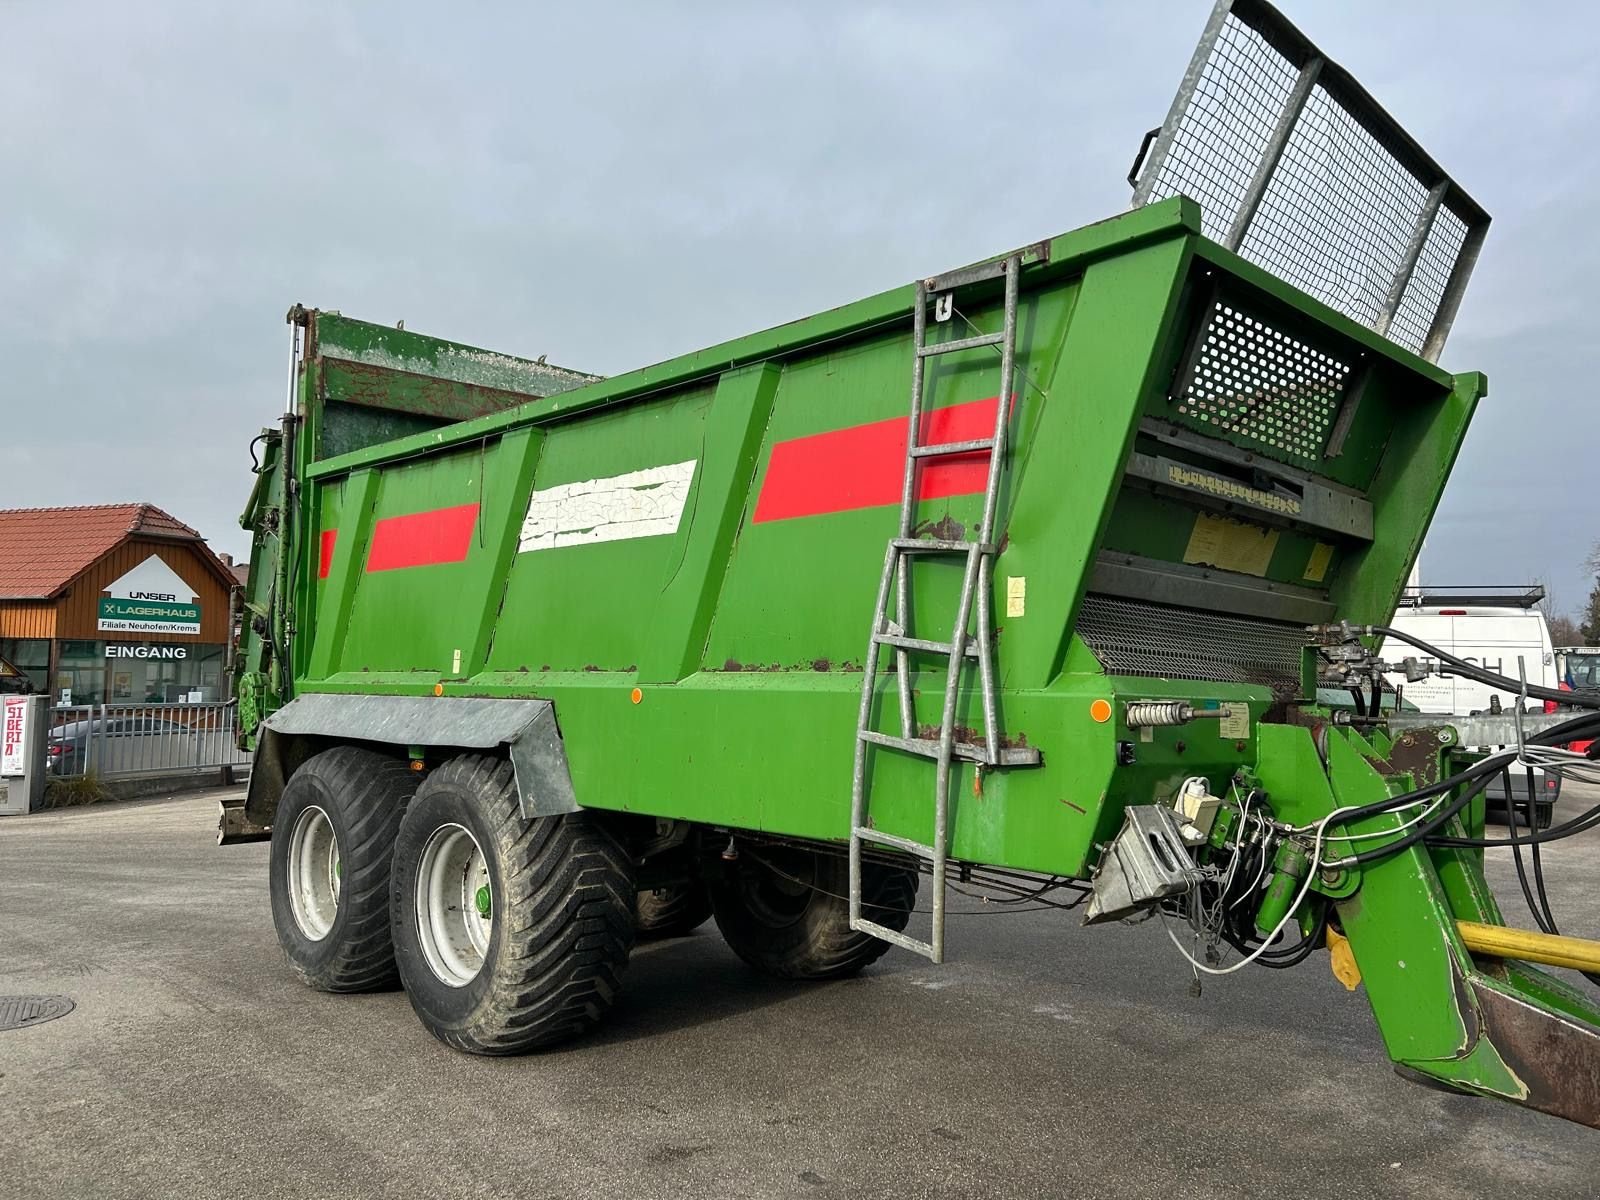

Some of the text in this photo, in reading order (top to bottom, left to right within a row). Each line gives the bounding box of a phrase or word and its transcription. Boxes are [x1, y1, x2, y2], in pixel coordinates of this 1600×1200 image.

[129, 591, 176, 602] UNSER
[117, 606, 197, 618] LAGERHAUS
[101, 621, 197, 632] Filiale Neuhofen/Krems
[105, 645, 187, 659] EINGANG
[1420, 656, 1503, 679] TEH
